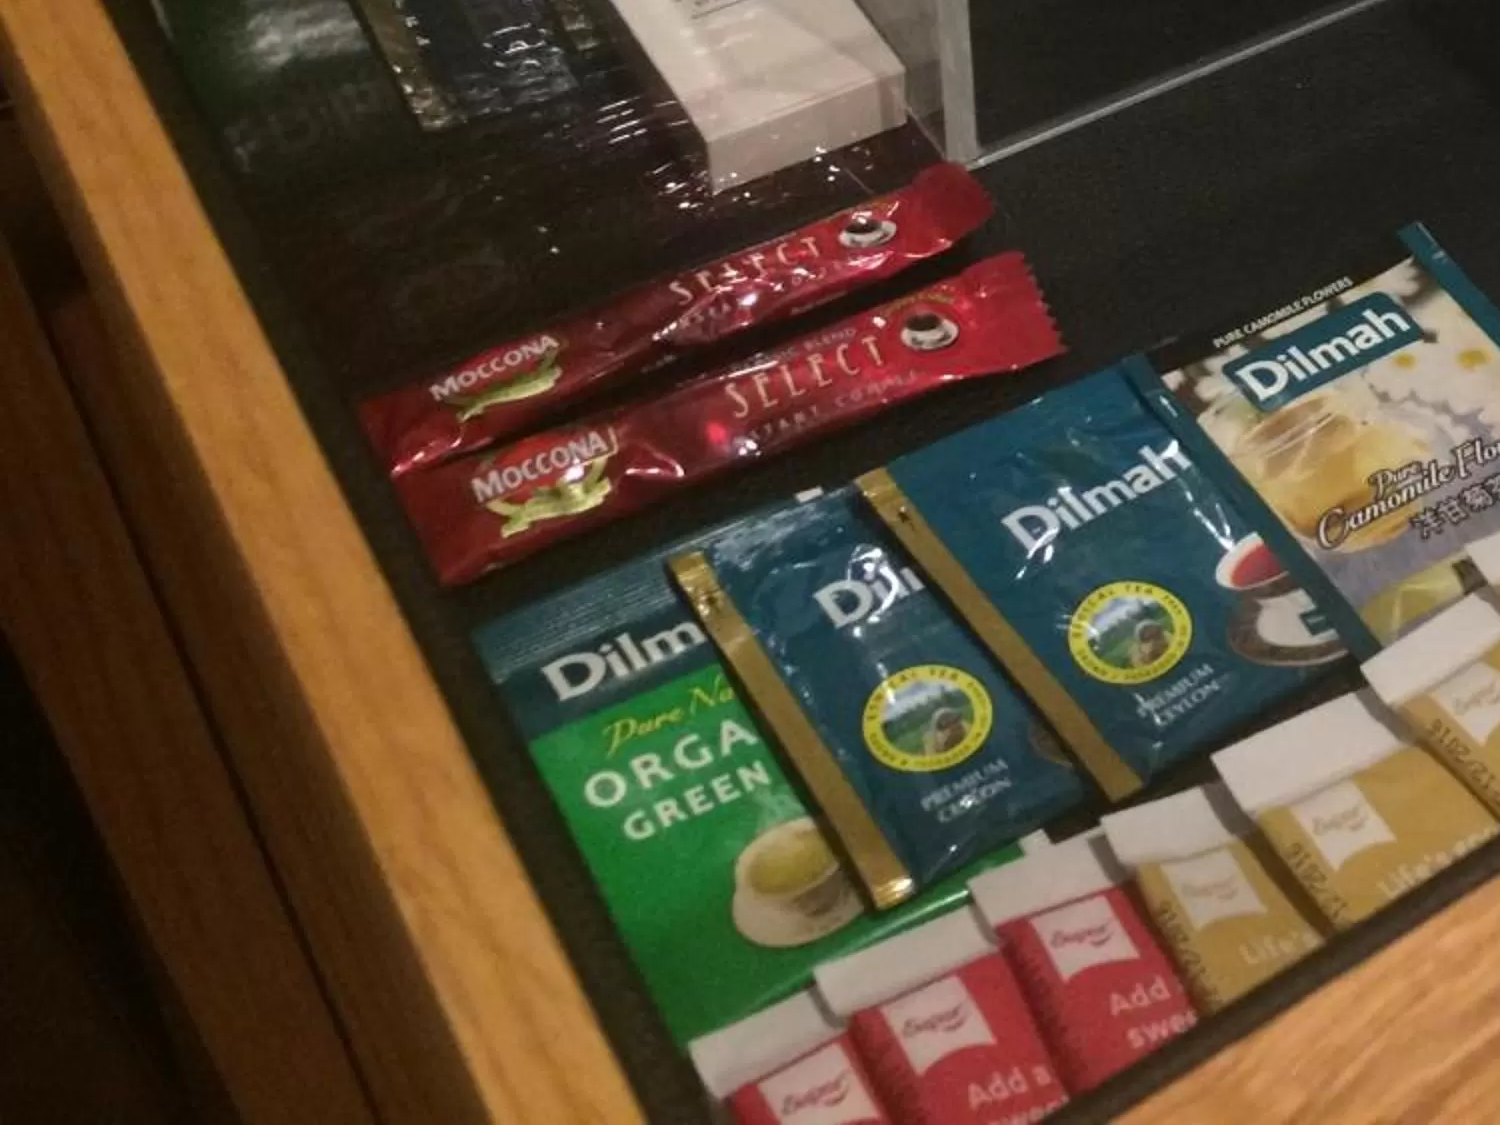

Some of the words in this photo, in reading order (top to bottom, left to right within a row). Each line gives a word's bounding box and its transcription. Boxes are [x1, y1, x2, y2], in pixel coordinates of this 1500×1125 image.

[1212, 325, 1245, 349] PURE
[1301, 276, 1355, 311] FLOWERS
[429, 334, 561, 402] MOCCONA
[724, 336, 885, 418] SELECT
[1235, 308, 1412, 402] Dilmah
[471, 430, 609, 504] MOCCONA
[1001, 440, 1193, 557] Dilmah
[1317, 458, 1457, 550] Camomile
[1369, 462, 1424, 497] Pure
[541, 621, 708, 702] Dilm
[584, 719, 759, 808] ORGA
[602, 717, 684, 760] Pure
[623, 760, 772, 841] GREEN
[920, 758, 1009, 812] PREMIUM
[1109, 976, 1172, 1018] Add
[967, 1066, 1029, 1111] Add
[1031, 1064, 1051, 1087] a
